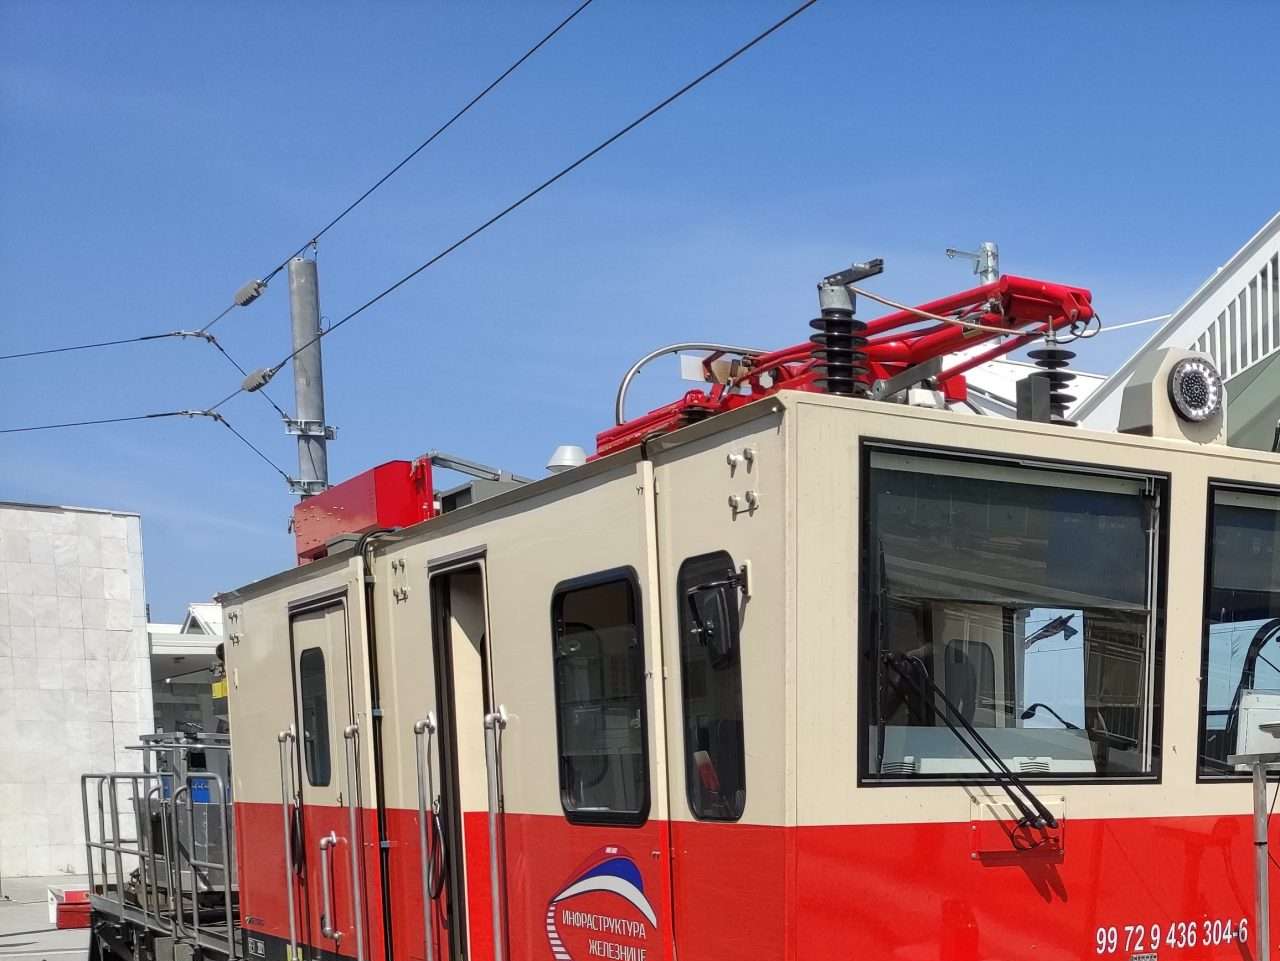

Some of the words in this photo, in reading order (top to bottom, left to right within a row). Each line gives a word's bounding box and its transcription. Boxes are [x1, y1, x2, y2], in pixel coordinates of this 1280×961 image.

[562, 909, 646, 939] ИНФРАСТРУКТУРА
[1096, 927, 1118, 954] 99
[1124, 925, 1144, 951] 72
[1150, 924, 1161, 950] 9
[1165, 922, 1197, 948] 436
[1202, 918, 1248, 946] 304-6
